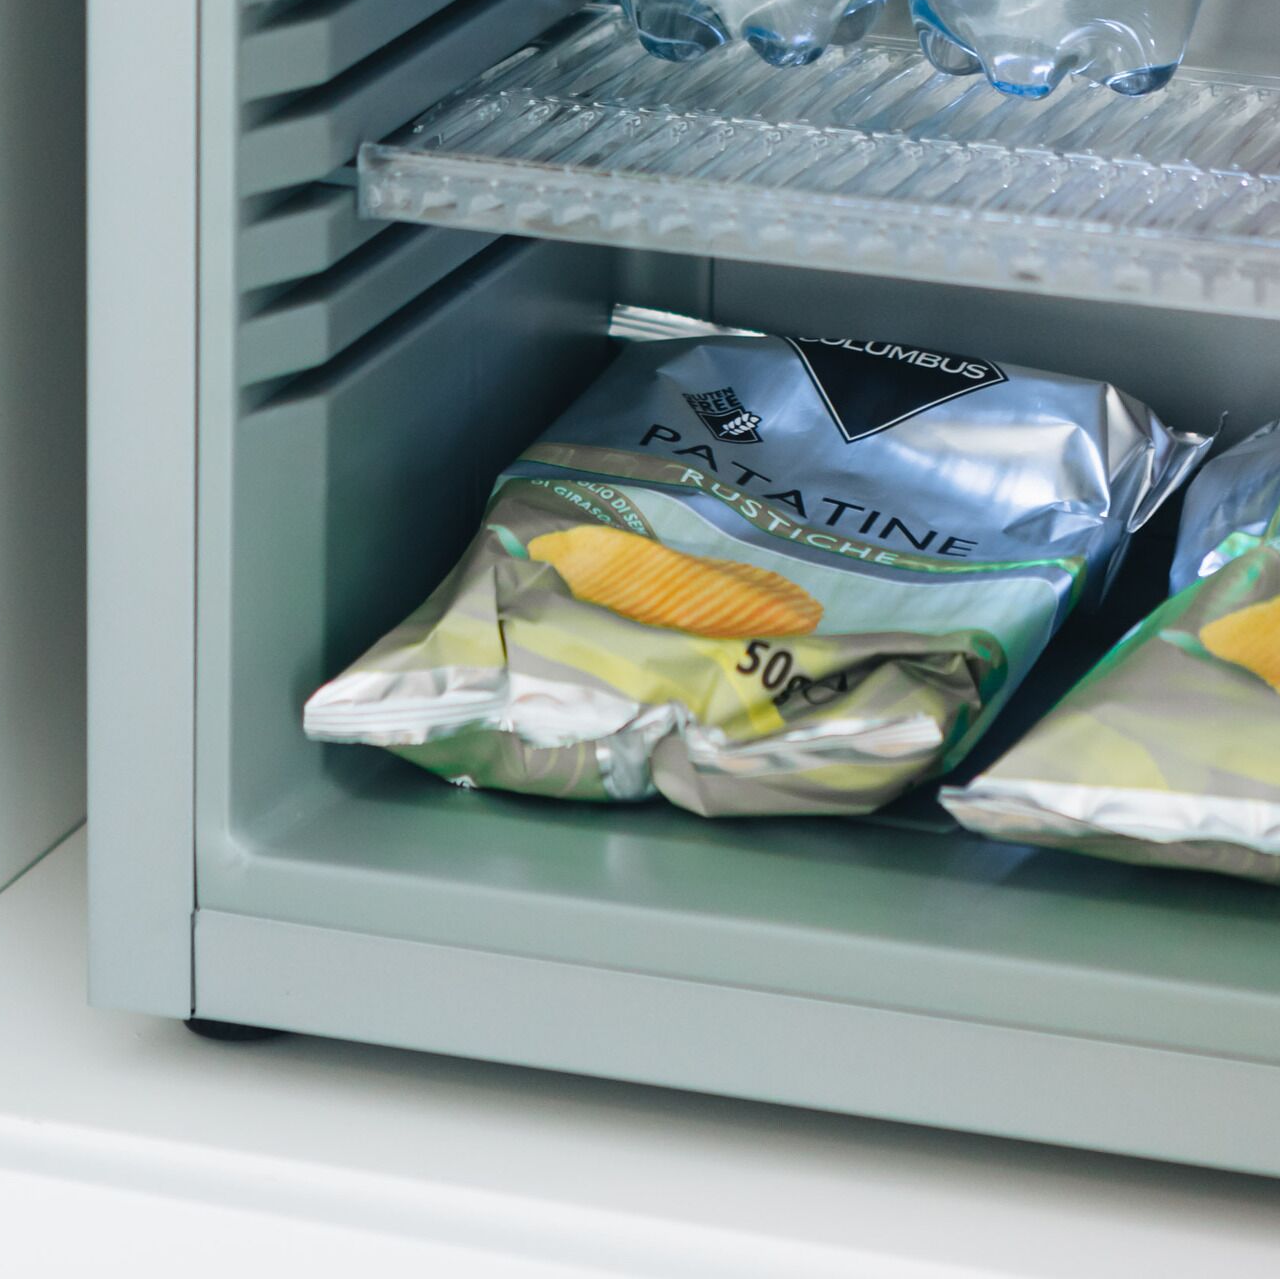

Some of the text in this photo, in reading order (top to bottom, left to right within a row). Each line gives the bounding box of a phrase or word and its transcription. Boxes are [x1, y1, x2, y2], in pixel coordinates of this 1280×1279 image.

[799, 337, 989, 380] LUMBUS
[553, 485, 614, 524] GIRASO
[639, 423, 979, 558] PATATINE
[680, 468, 900, 567] RUSTICHE
